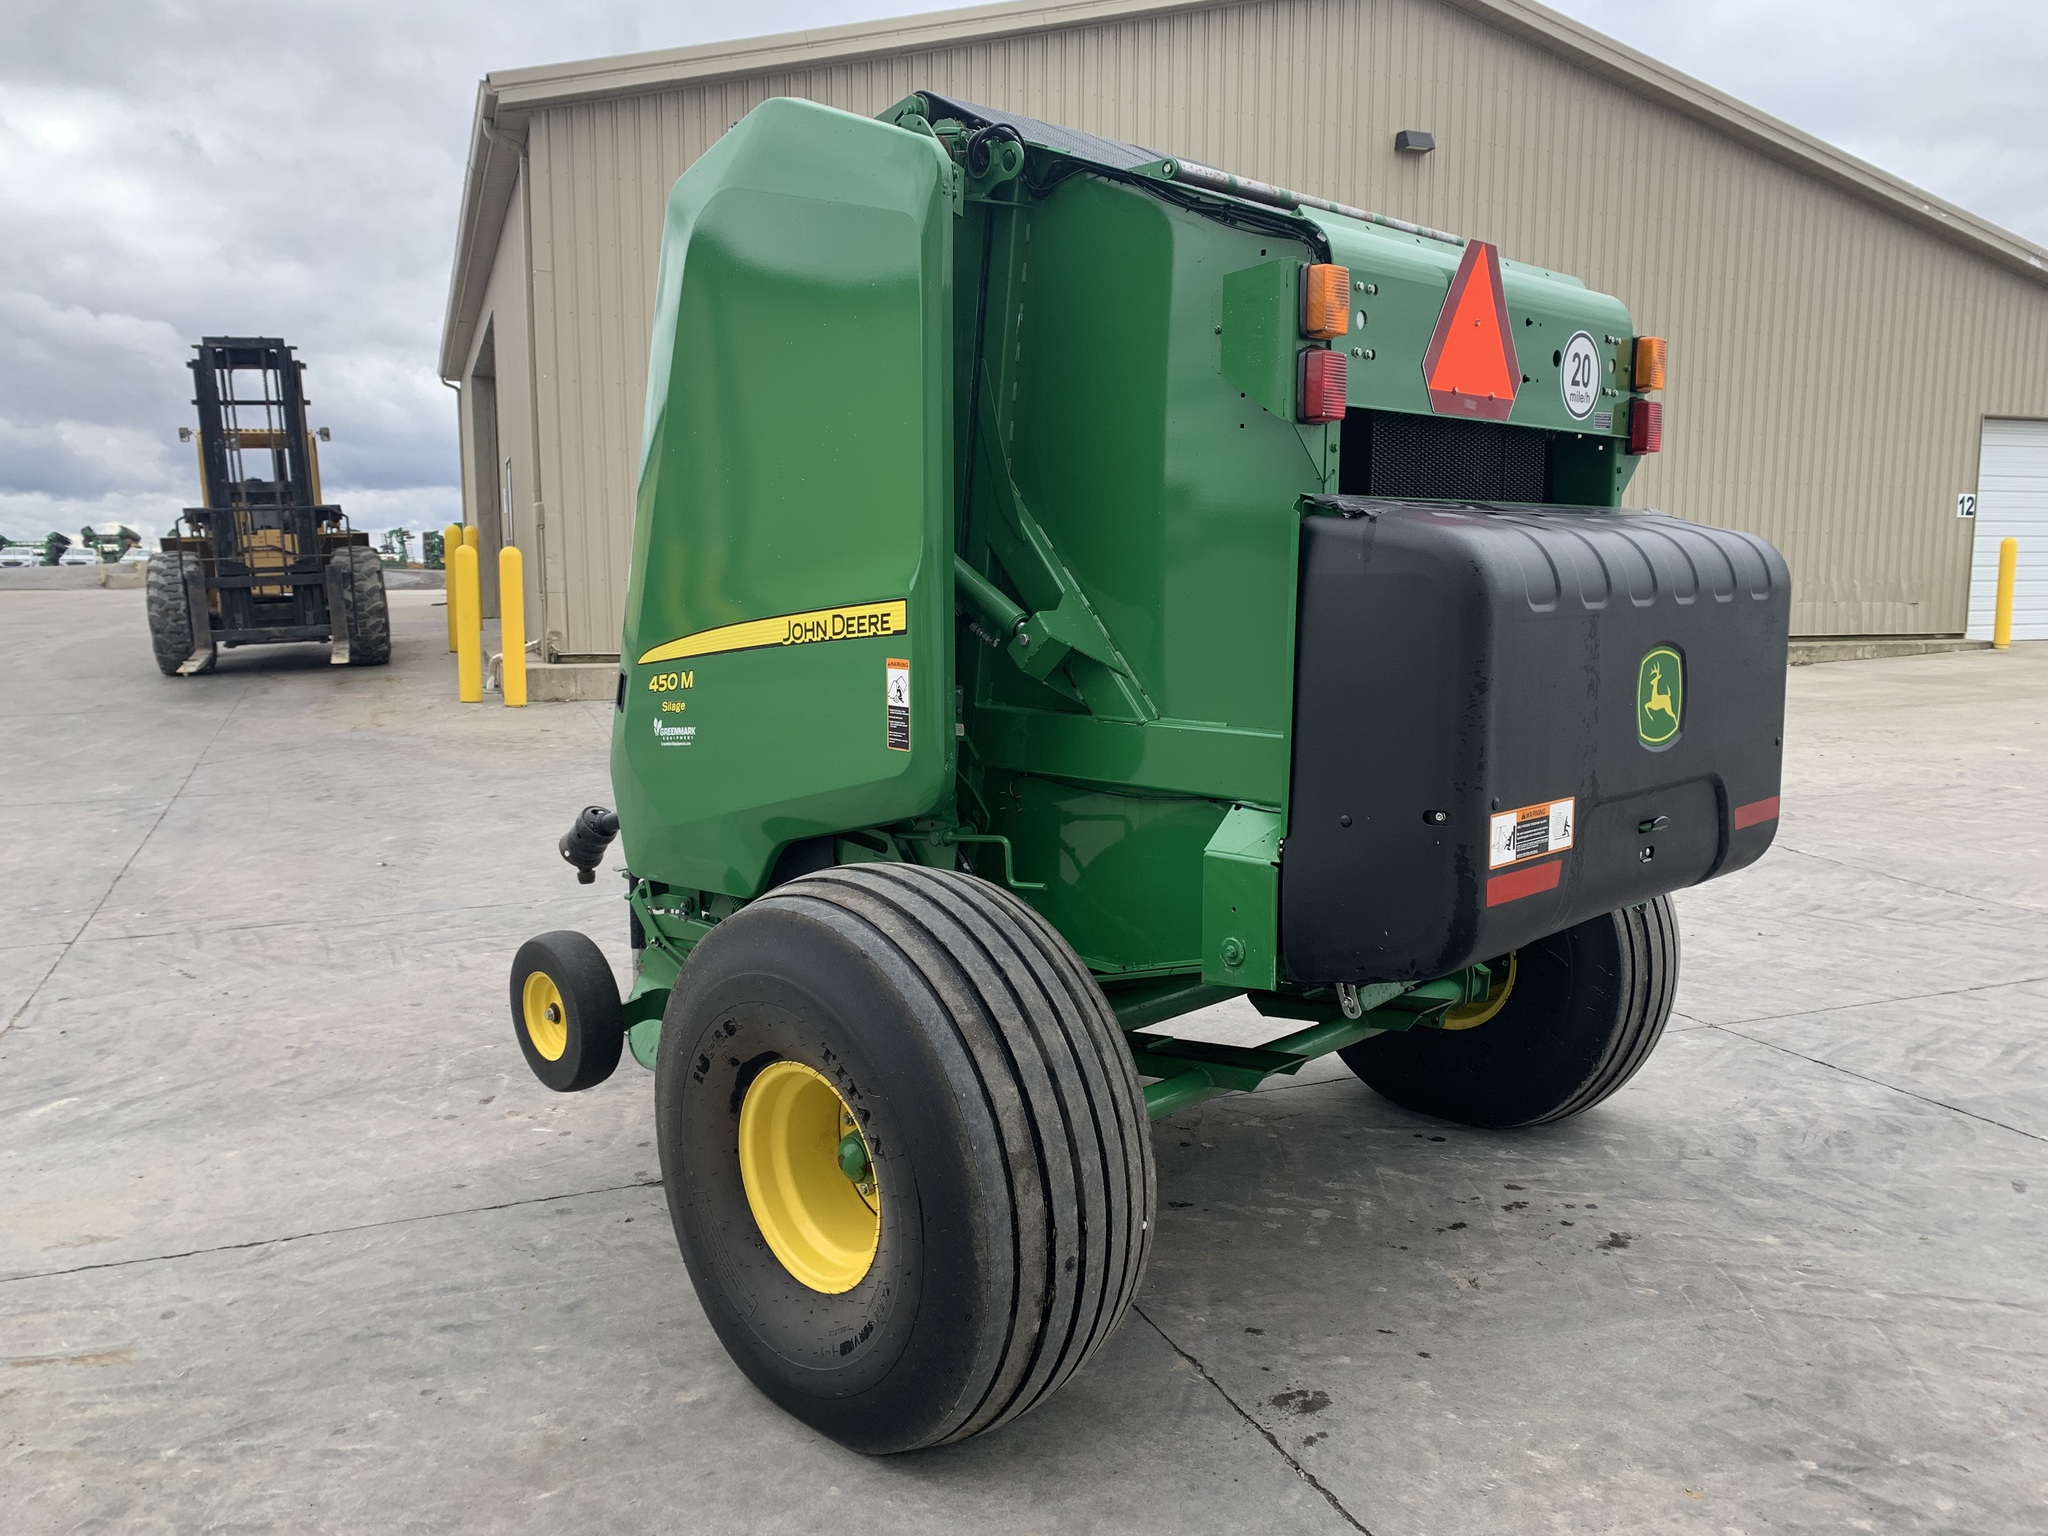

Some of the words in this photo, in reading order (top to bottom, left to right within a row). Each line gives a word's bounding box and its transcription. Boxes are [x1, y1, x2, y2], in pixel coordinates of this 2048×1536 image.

[1571, 352, 1591, 388] 20
[1569, 391, 1591, 404] mile/h
[1959, 496, 1975, 516] 12
[782, 619, 827, 643] JOHN
[831, 612, 892, 638] DEERE
[648, 672, 679, 693] 450
[680, 670, 694, 689] M
[661, 701, 686, 713] Silage
[660, 726, 696, 736] GREENMARK
[1525, 808, 1546, 818] WARNING
[819, 1042, 888, 1162] TITAN
